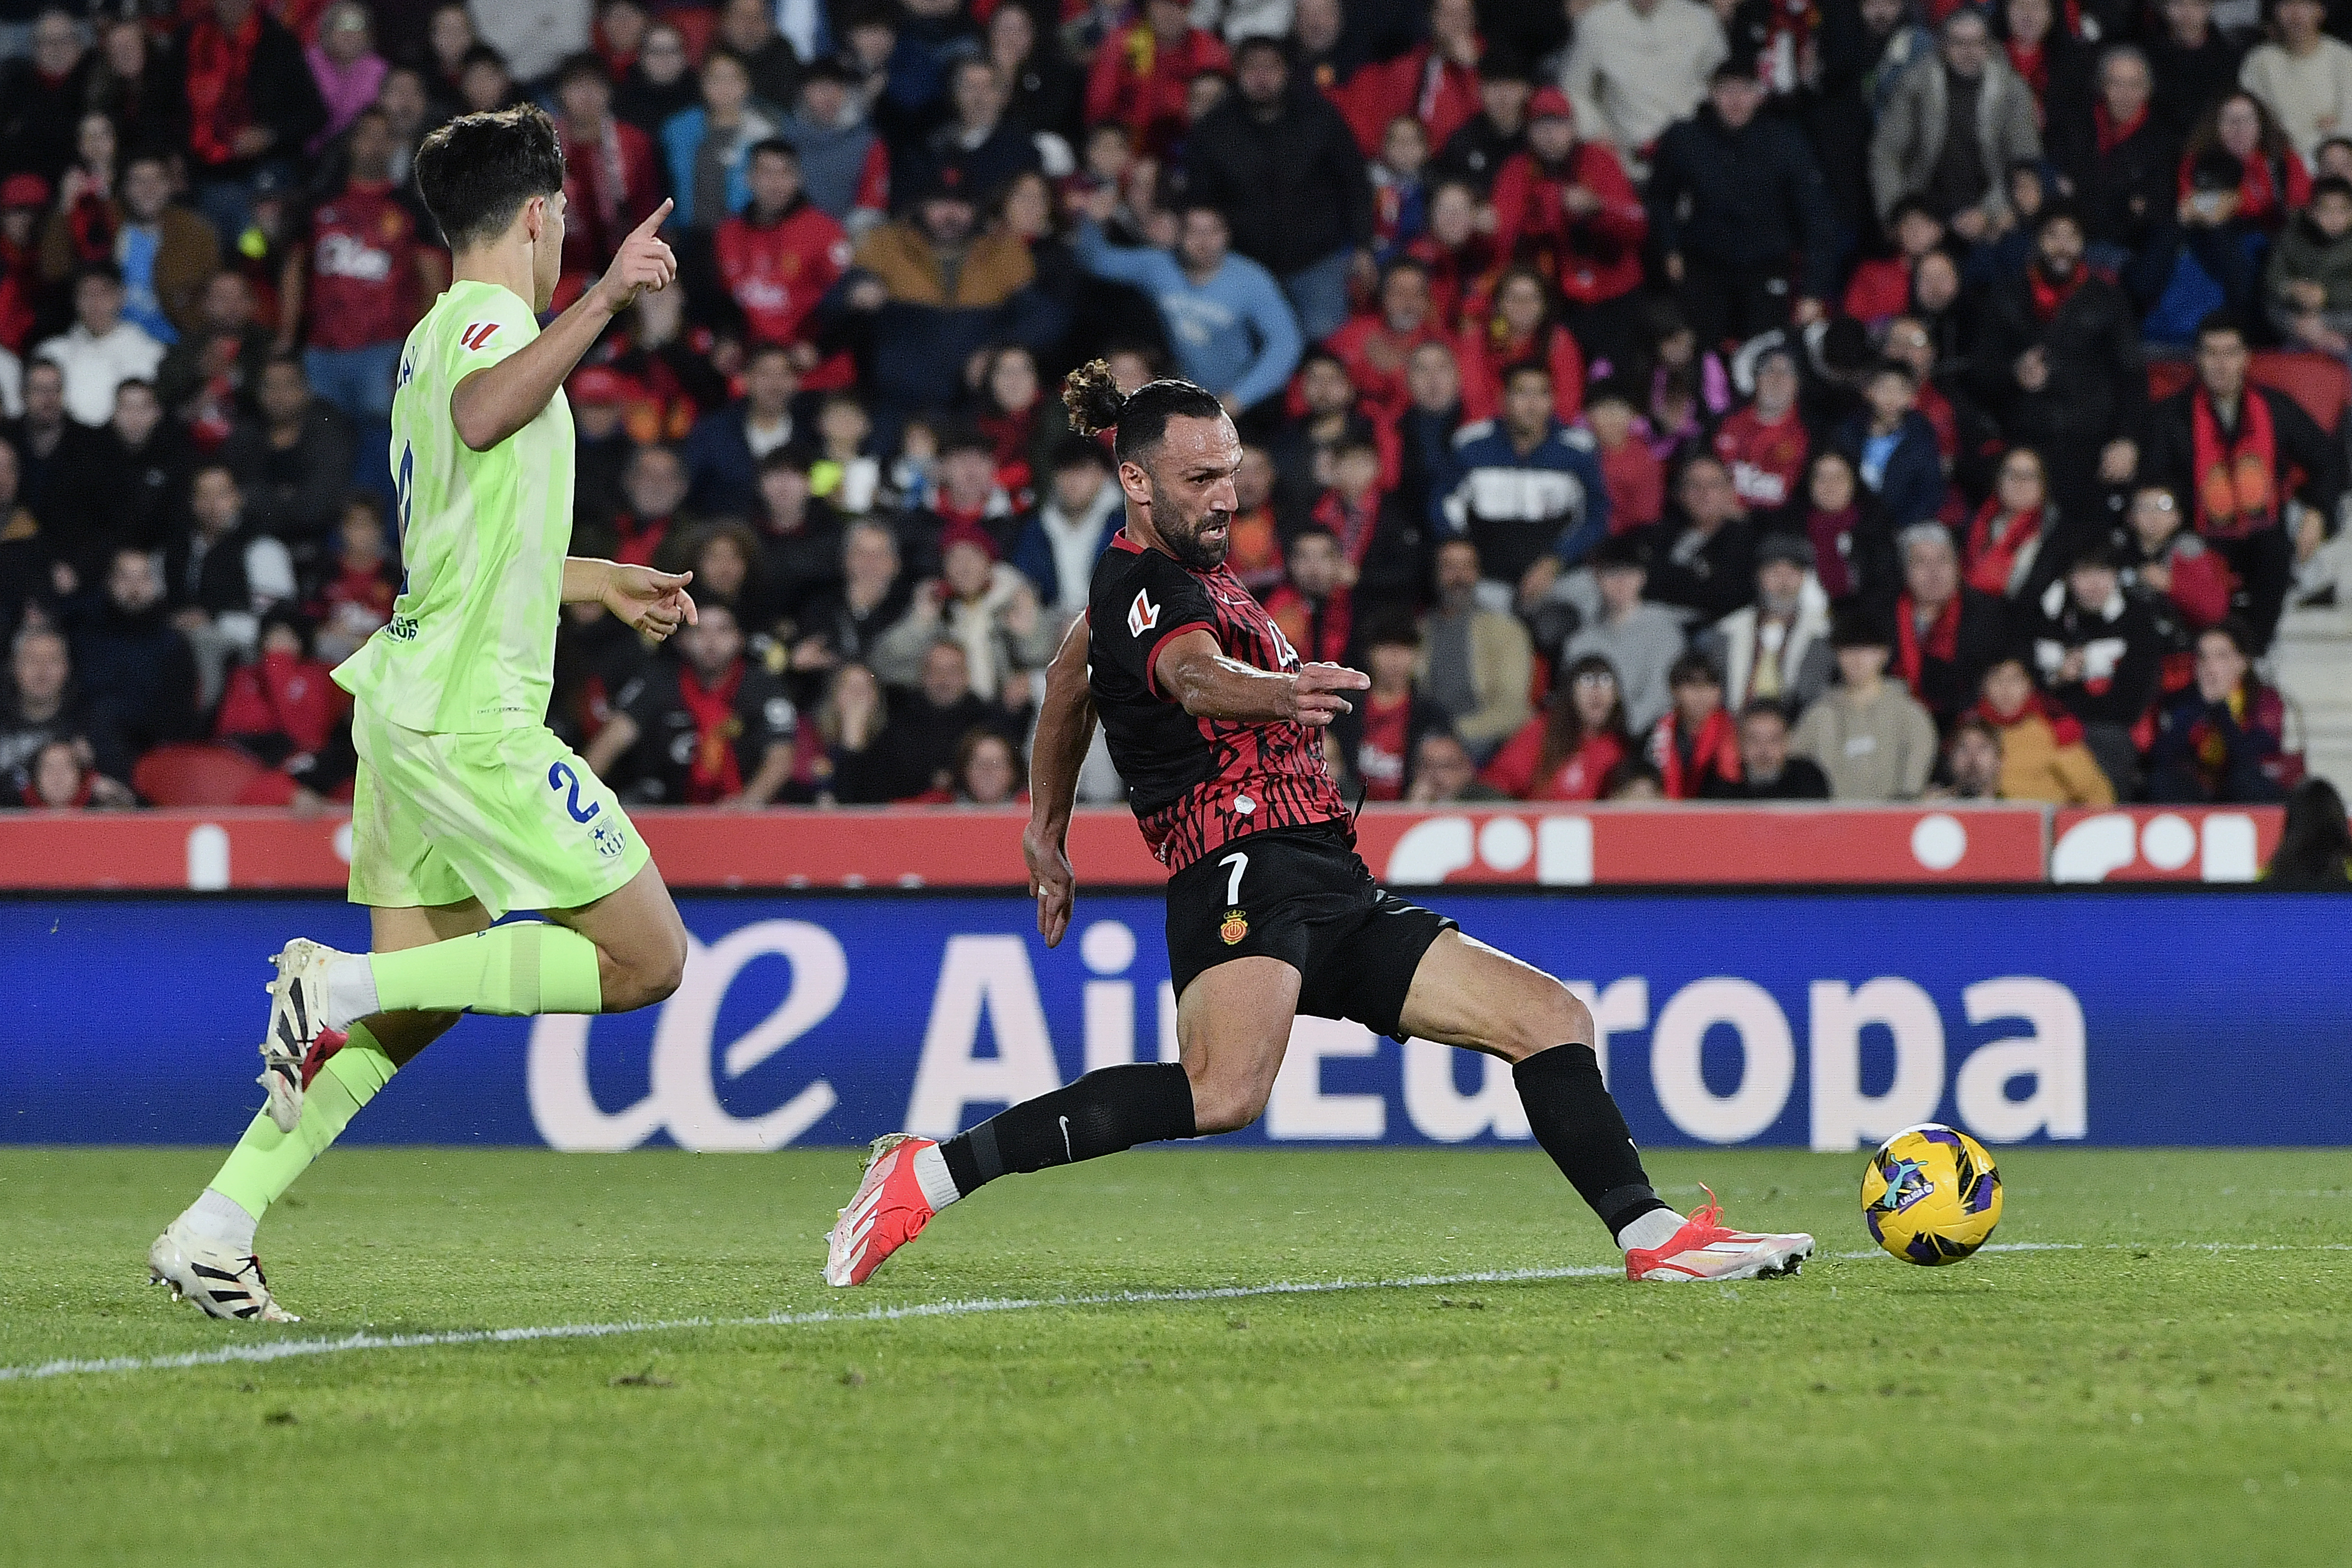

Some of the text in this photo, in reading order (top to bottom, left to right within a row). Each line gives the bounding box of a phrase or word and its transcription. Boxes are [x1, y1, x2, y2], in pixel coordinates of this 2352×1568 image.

[548, 761, 600, 824] 2
[1218, 852, 1249, 905] 7
[1899, 1188, 1925, 1205] LALIGA
